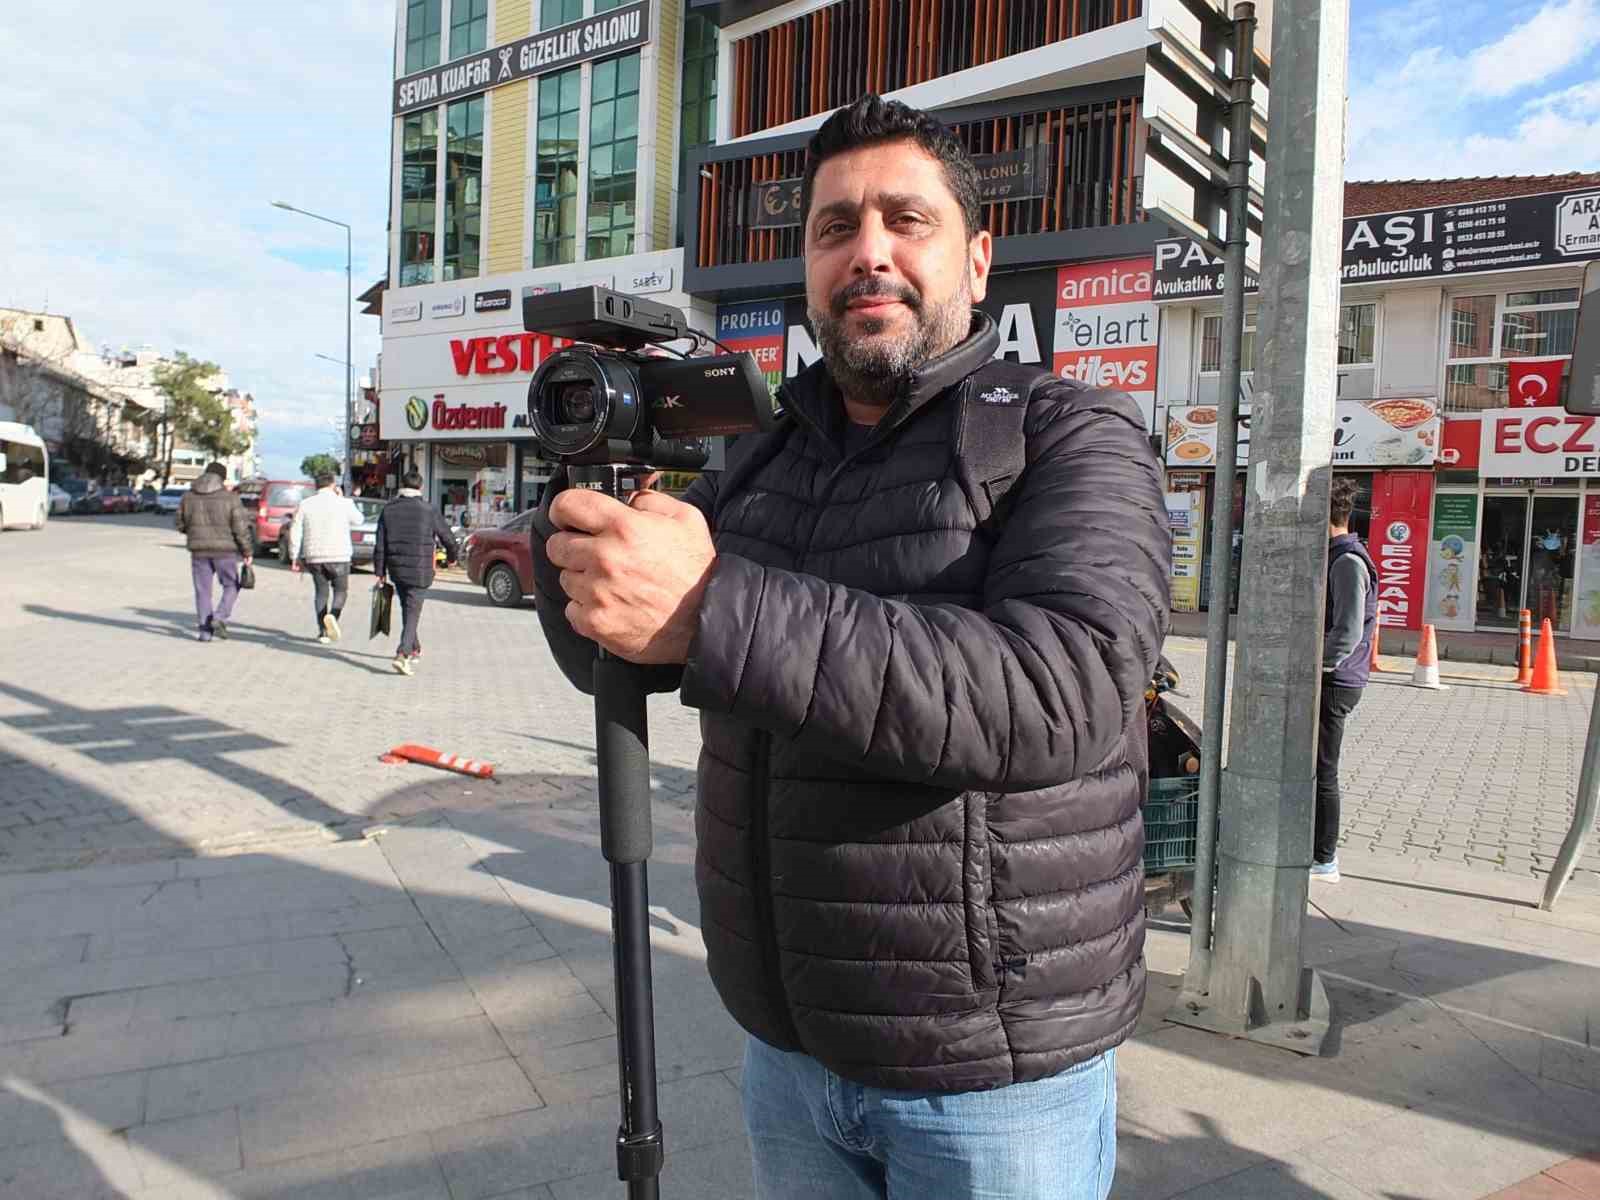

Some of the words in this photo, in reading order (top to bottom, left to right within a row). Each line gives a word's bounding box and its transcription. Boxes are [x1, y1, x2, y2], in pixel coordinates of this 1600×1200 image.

[399, 80, 438, 106] SEVDA
[583, 10, 641, 51] SALONU
[975, 163, 1018, 180] ALONU
[1061, 268, 1151, 301] arnica
[1154, 274, 1213, 297] Avukatlık
[1074, 312, 1149, 347] elart
[450, 332, 577, 378] VEST
[1060, 354, 1148, 387] stilevs
[704, 367, 737, 378] SONY
[431, 393, 508, 431] Özdemir
[1494, 415, 1600, 454] ECZ
[1564, 456, 1600, 472] DE
